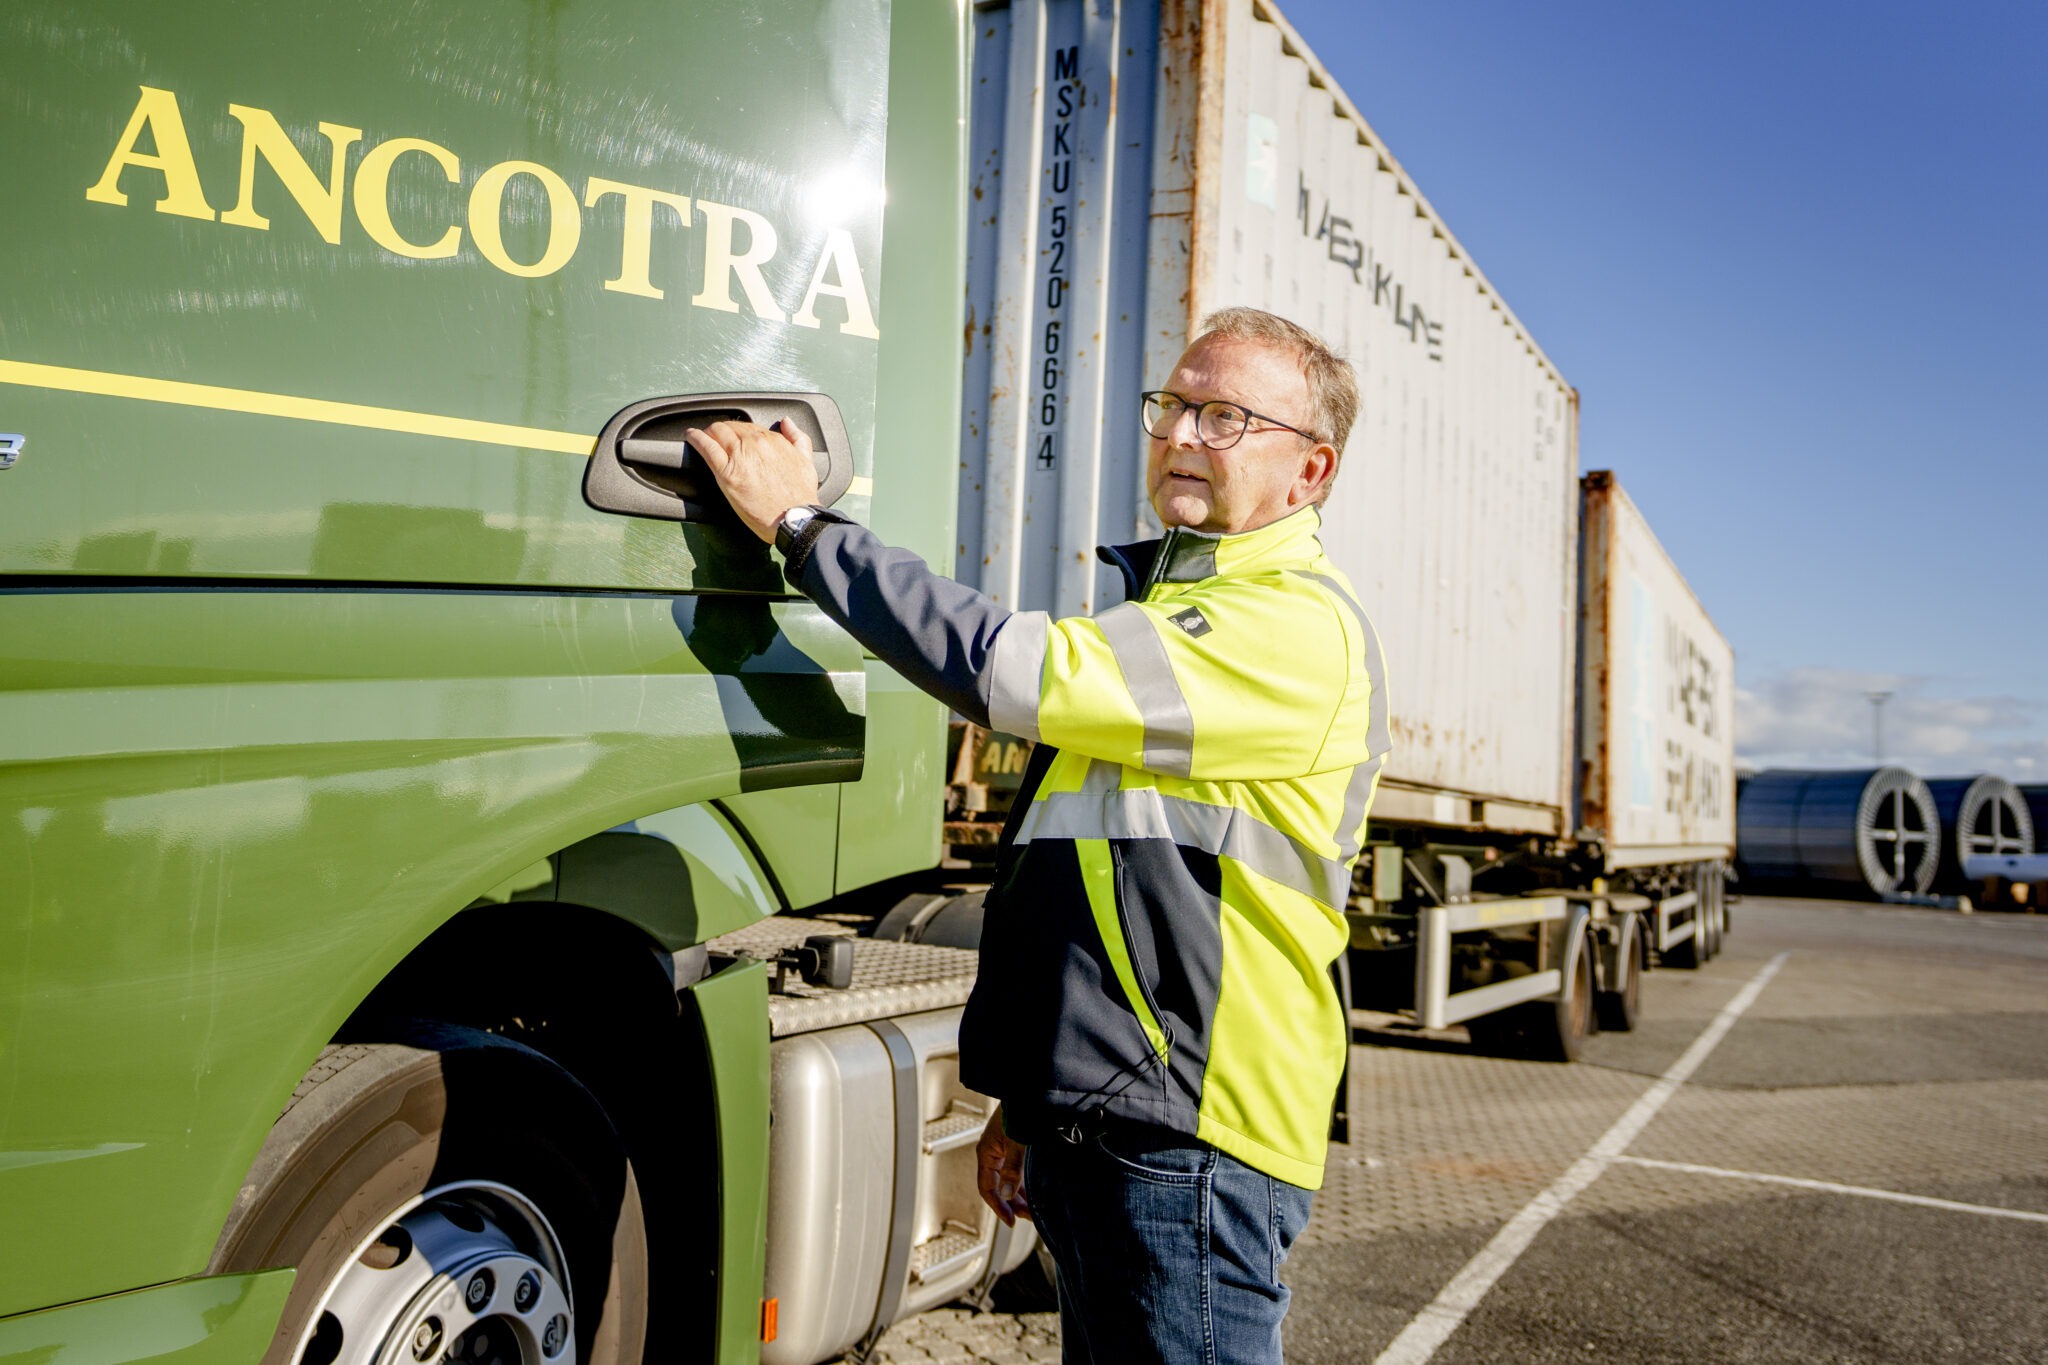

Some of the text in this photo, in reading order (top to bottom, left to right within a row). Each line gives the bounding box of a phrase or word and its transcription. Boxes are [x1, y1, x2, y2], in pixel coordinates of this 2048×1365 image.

[1054, 46, 1079, 194] MSKU
[86, 85, 880, 340] ANCOTRA
[1047, 205, 1067, 310] 520
[1297, 168, 1444, 362] MAERK LNE
